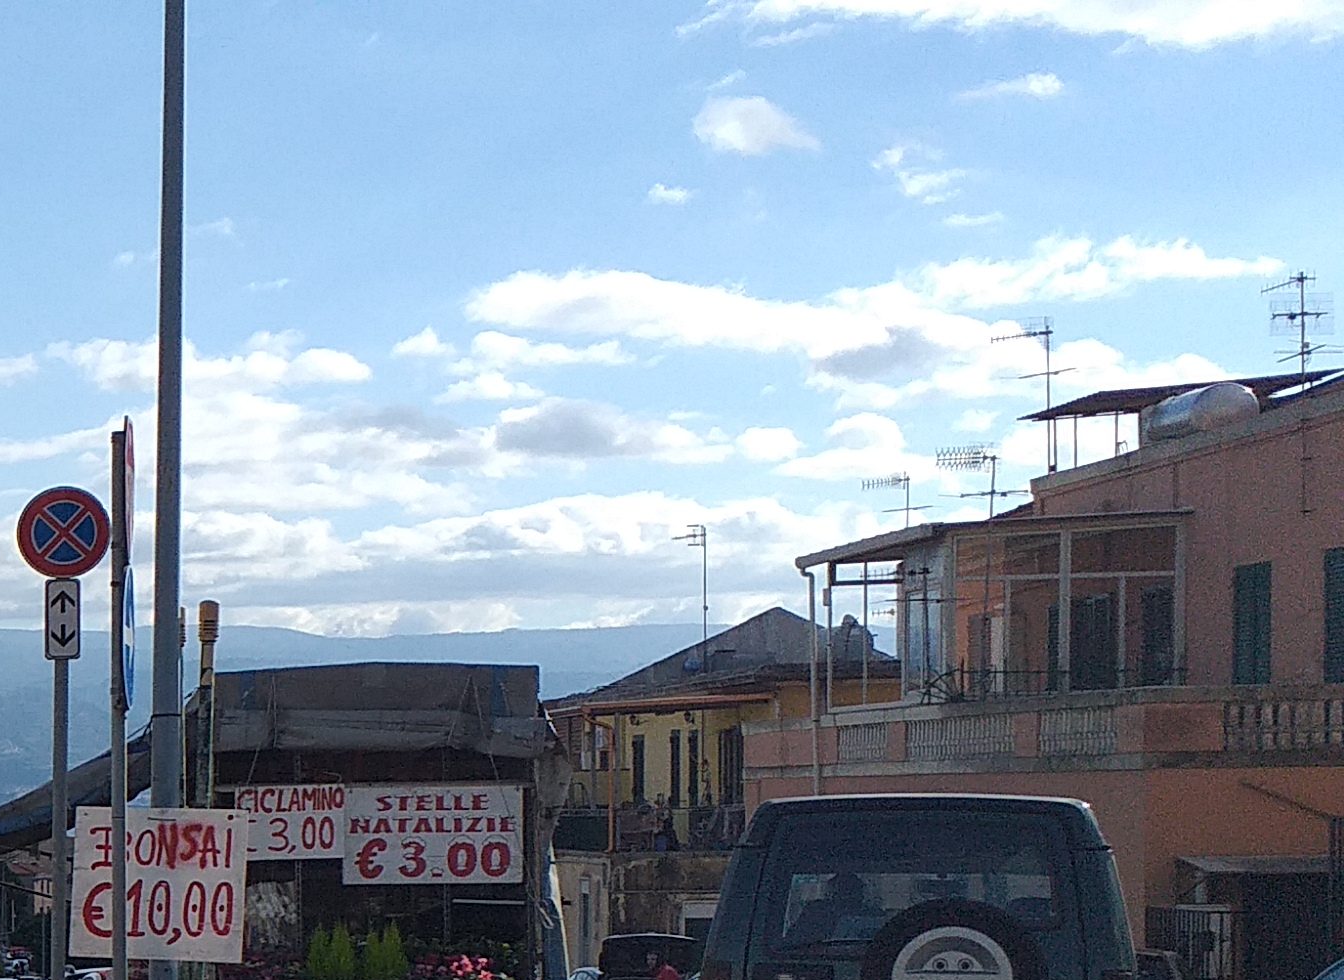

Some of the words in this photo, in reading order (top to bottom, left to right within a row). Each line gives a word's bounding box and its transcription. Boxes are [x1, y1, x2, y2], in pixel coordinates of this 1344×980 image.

[236, 786, 345, 814] CICLAMINO
[376, 794, 490, 812] STELLE
[349, 816, 516, 834] NATALIZIE
